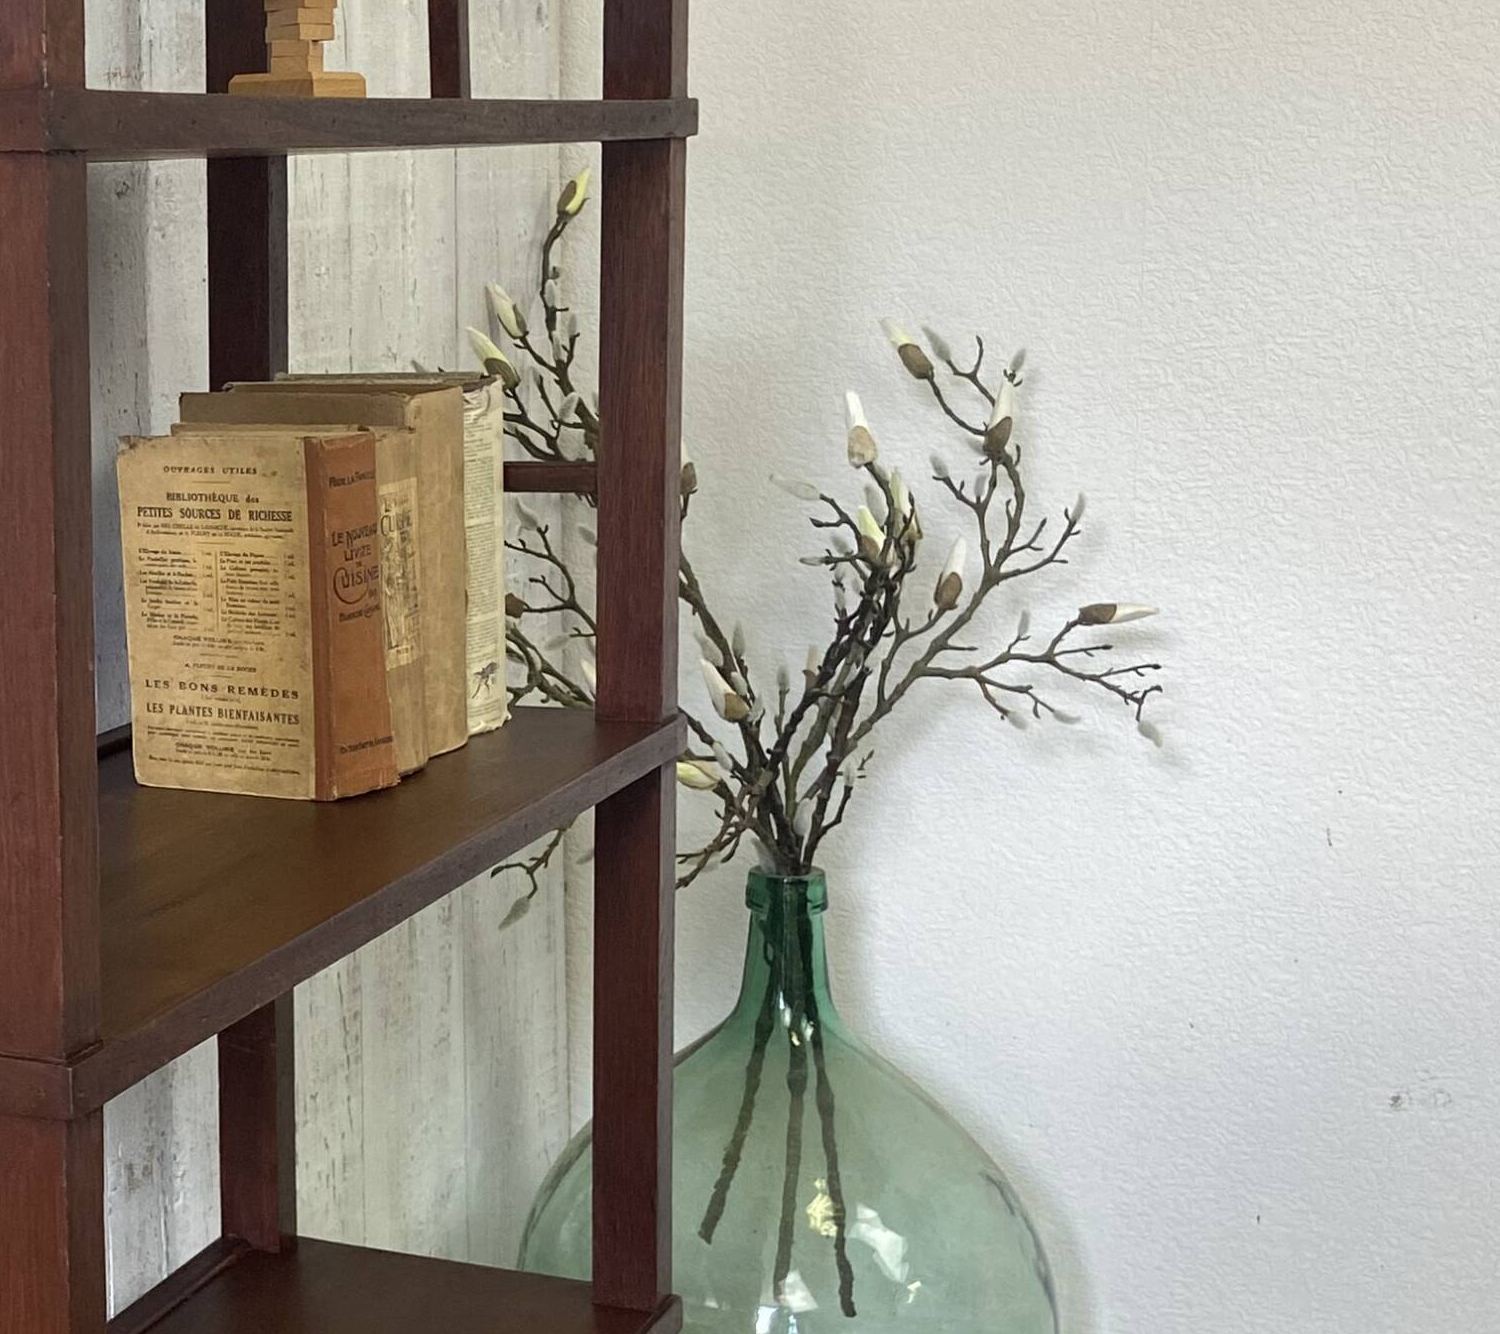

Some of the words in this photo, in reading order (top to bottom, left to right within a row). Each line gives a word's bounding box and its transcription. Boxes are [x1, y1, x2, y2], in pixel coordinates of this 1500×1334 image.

[163, 465, 215, 474] OUVRAGES
[222, 467, 257, 475] UTILES
[166, 492, 239, 503] BIBLIOTHÈQUE
[245, 494, 259, 503] des
[137, 507, 173, 518] PETITES
[179, 508, 221, 520] SOURCES
[228, 509, 241, 520] DE
[248, 510, 292, 522] RICHESSE
[145, 679, 170, 689] LES
[179, 681, 219, 693] BONS
[227, 684, 299, 699] REMÈDES
[146, 703, 164, 714] LES
[169, 704, 213, 718] PLANTES
[218, 707, 299, 725] BIENFAISANTES
